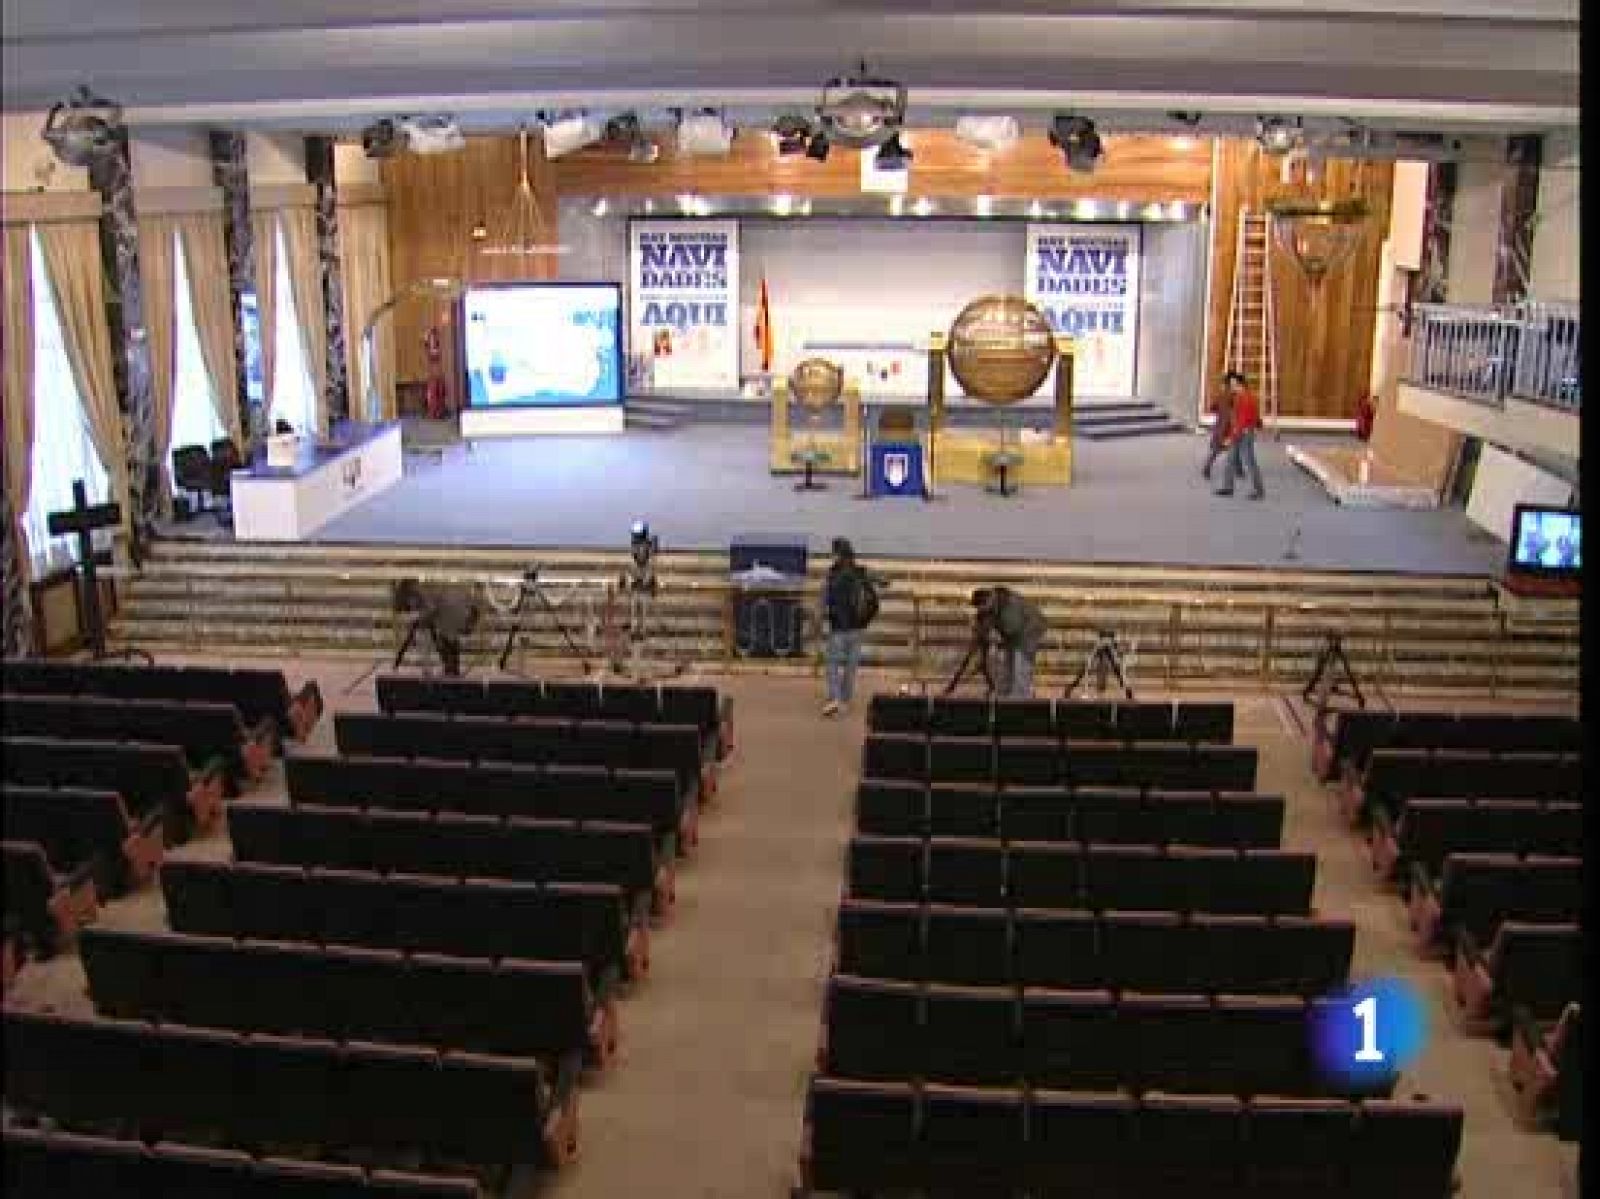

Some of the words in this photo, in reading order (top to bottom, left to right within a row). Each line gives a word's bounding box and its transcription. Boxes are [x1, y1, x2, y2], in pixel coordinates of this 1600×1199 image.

[640, 244, 727, 266] NAVI
[1038, 249, 1127, 274] NAVI
[640, 271, 727, 288] DADES
[1038, 278, 1127, 294] DADES
